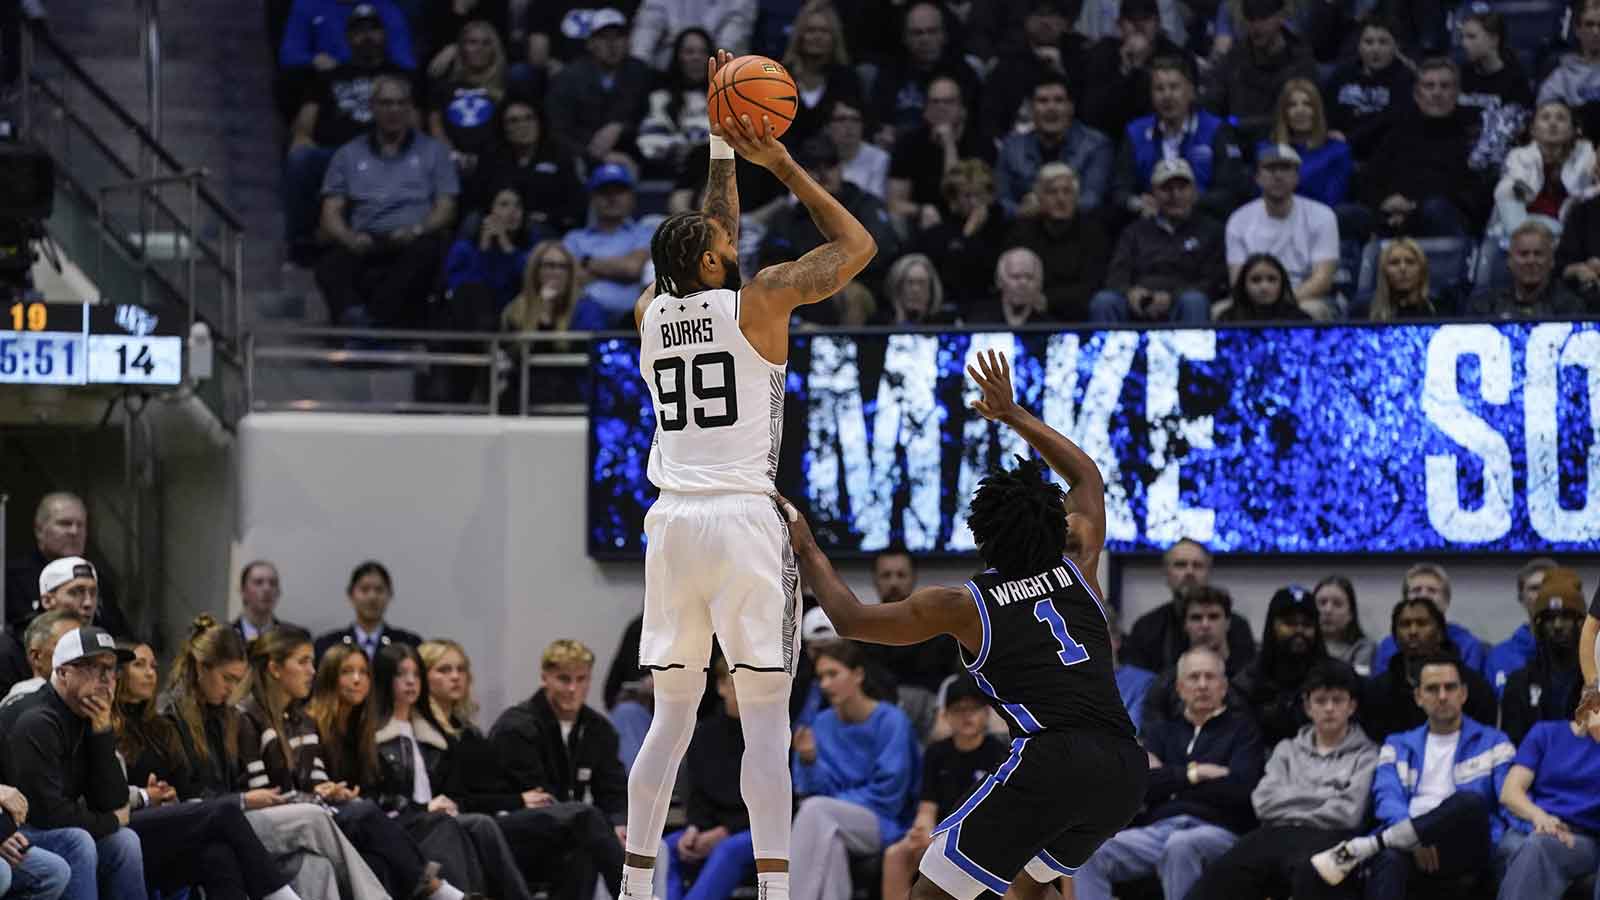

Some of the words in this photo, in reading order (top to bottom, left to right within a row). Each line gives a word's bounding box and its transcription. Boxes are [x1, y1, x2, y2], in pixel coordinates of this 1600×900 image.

[10, 302, 47, 331] 19
[660, 318, 713, 349] BURKS
[0, 339, 74, 376] 5:51
[116, 344, 154, 375] 14
[653, 350, 738, 432] 99
[989, 571, 1054, 607] WRIGHT
[1052, 565, 1074, 589] III
[1033, 597, 1090, 666] 1
